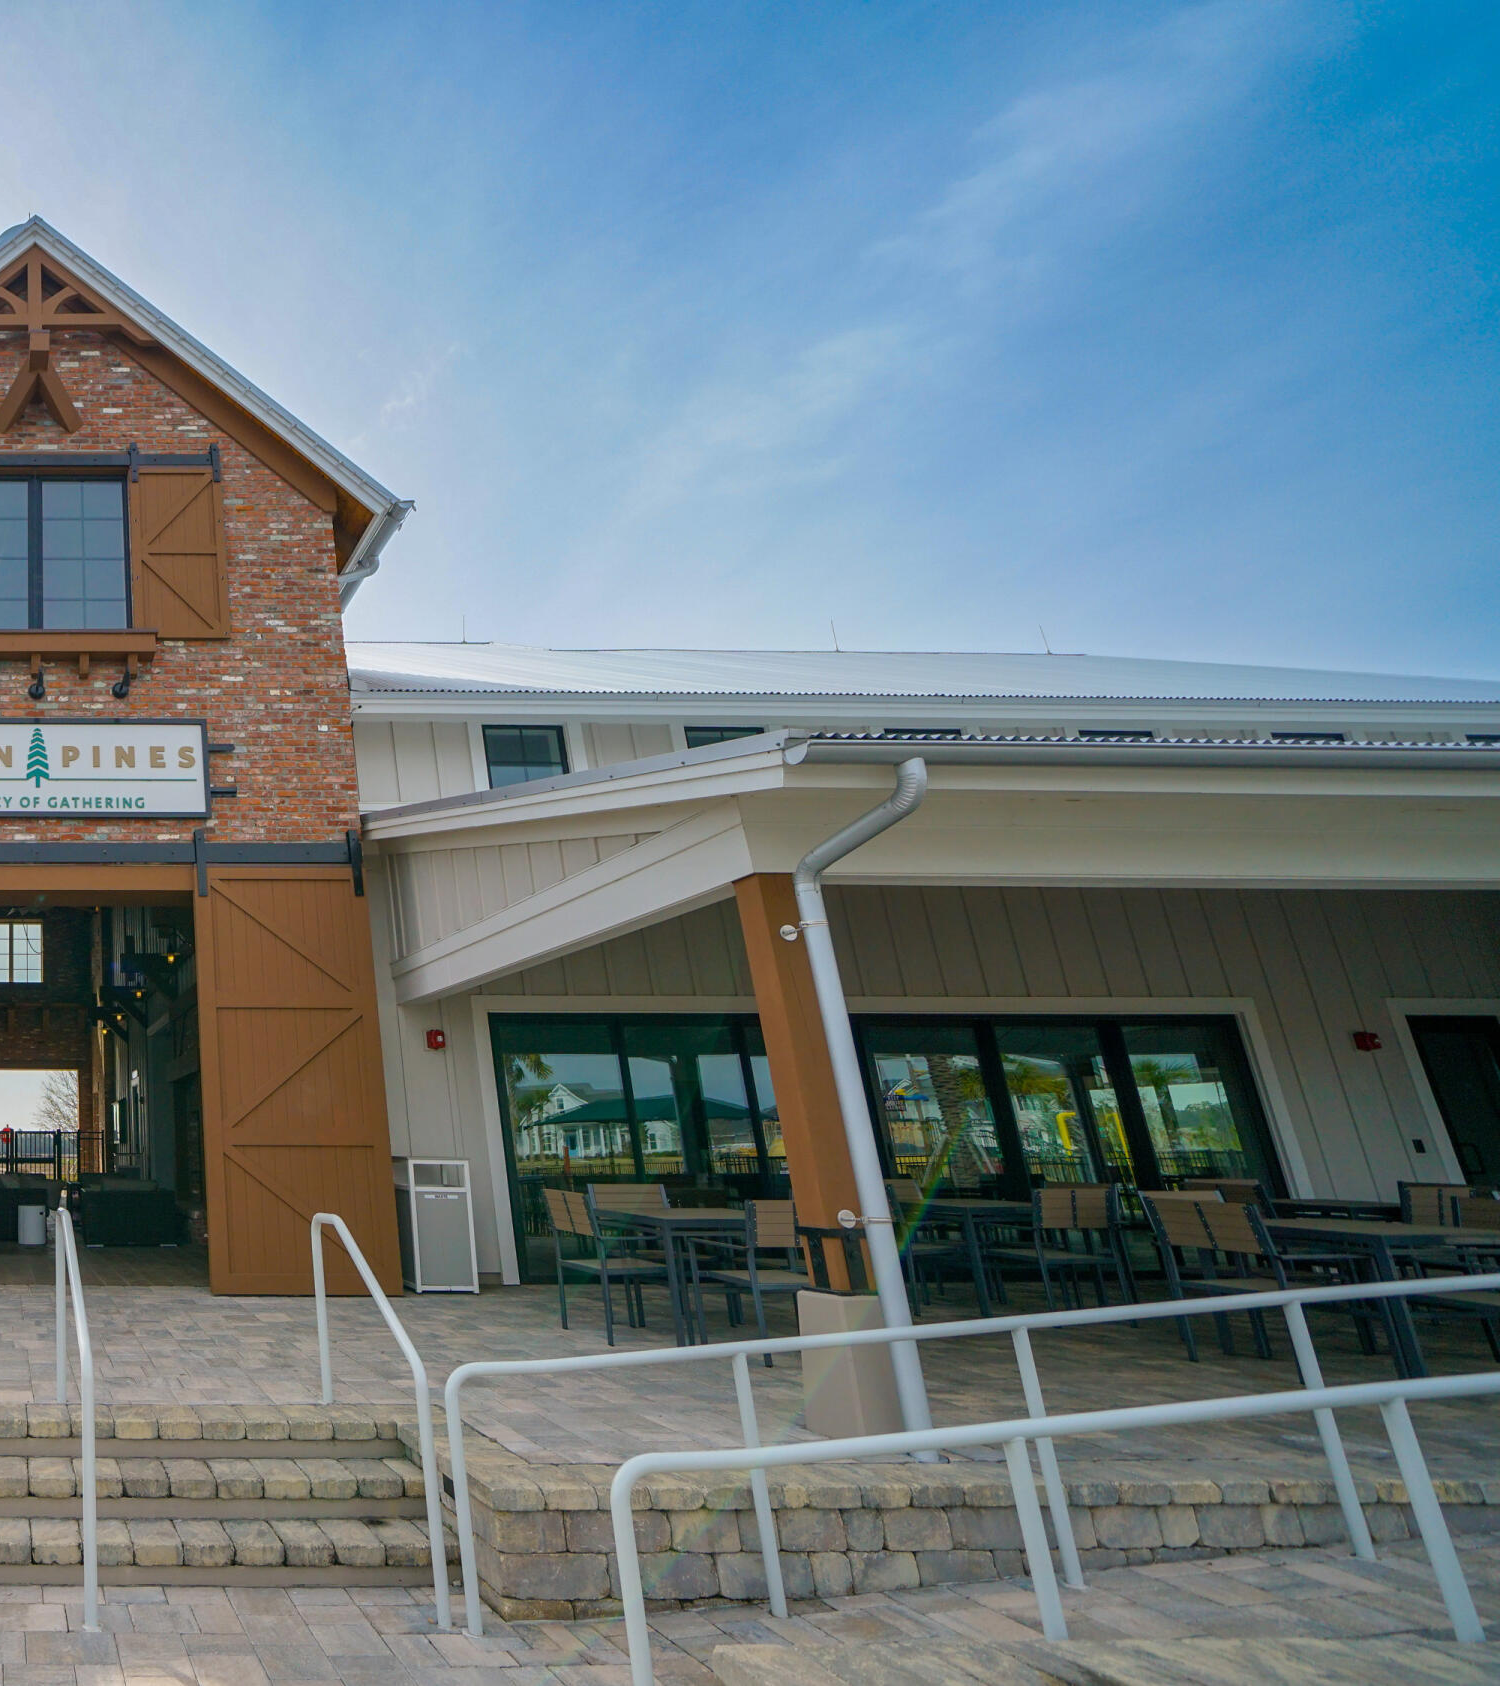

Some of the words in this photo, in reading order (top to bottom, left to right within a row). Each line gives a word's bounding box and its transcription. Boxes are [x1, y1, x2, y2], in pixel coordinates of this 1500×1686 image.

[61, 745, 196, 769] PINES
[19, 796, 40, 809] OF
[47, 796, 146, 810] GATHERING
